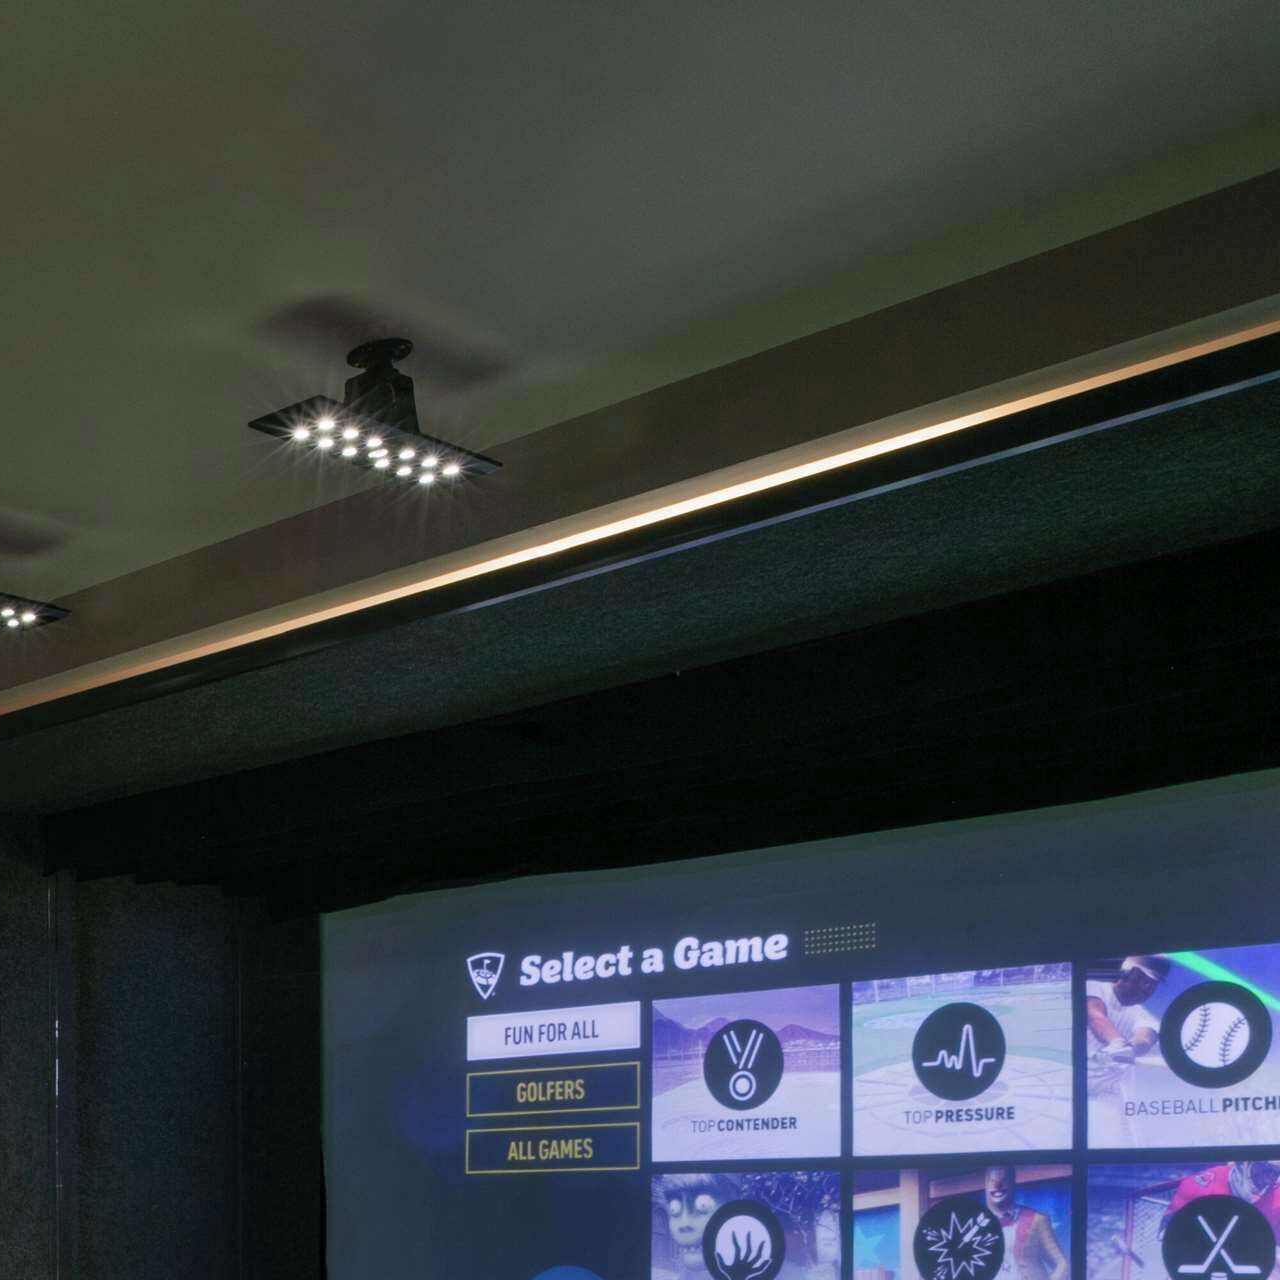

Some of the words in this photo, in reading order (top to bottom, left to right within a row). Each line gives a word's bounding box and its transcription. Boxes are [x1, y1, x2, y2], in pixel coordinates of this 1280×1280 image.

[520, 945, 632, 987] Select
[641, 947, 664, 974] a
[673, 933, 789, 970] Game
[504, 1026, 534, 1046] FUN
[538, 1023, 568, 1043] FOR
[571, 1020, 599, 1040] ALL
[516, 1080, 585, 1103] GOLFERS
[507, 1141, 535, 1161] ALL
[539, 1138, 593, 1160] GAMES
